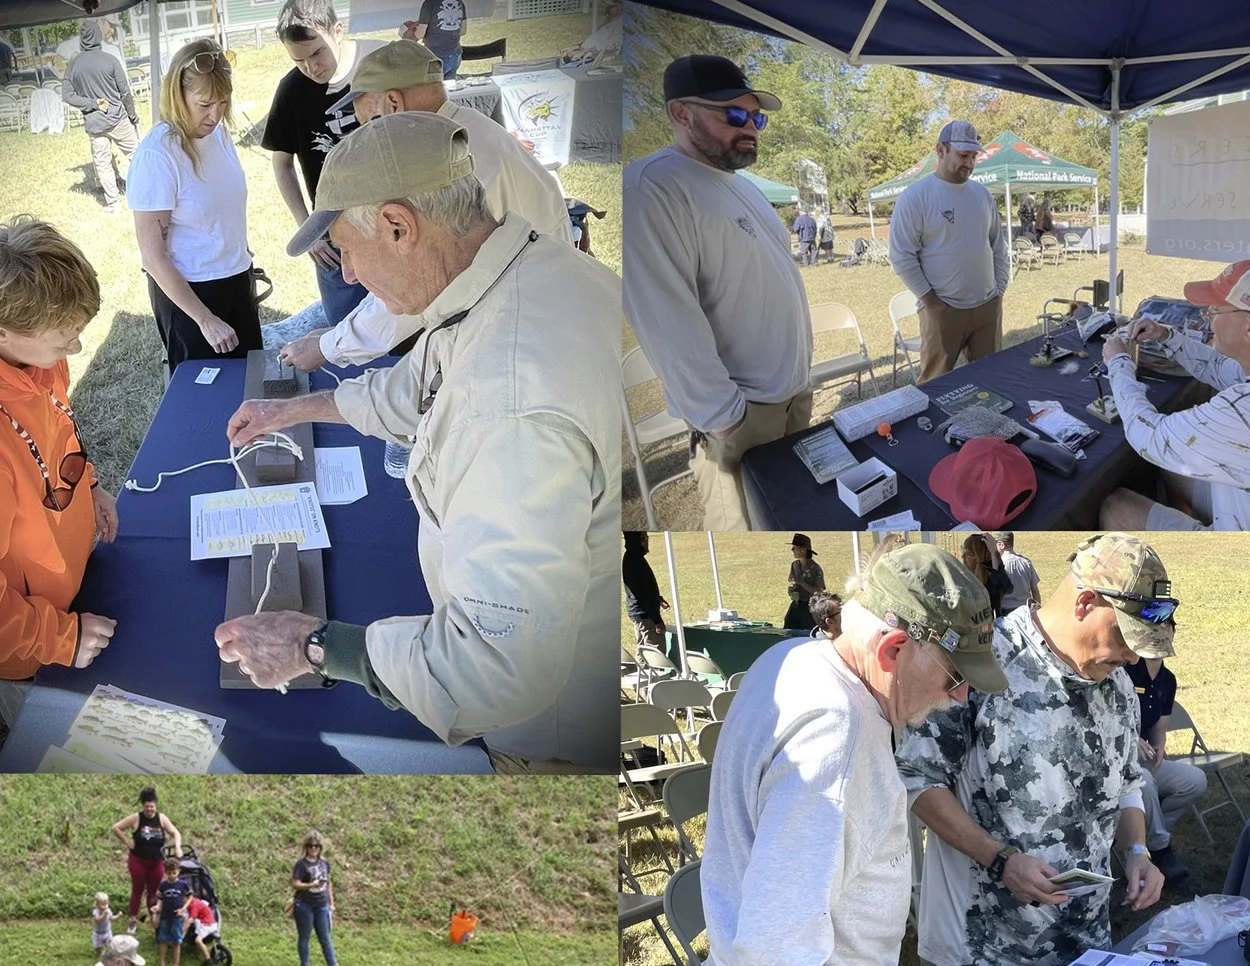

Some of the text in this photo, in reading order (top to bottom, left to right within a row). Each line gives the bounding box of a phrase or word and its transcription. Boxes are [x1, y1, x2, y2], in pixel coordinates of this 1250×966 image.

[1016, 170, 1092, 183] National Park Service
[463, 596, 530, 614] OMNI-SHADE
